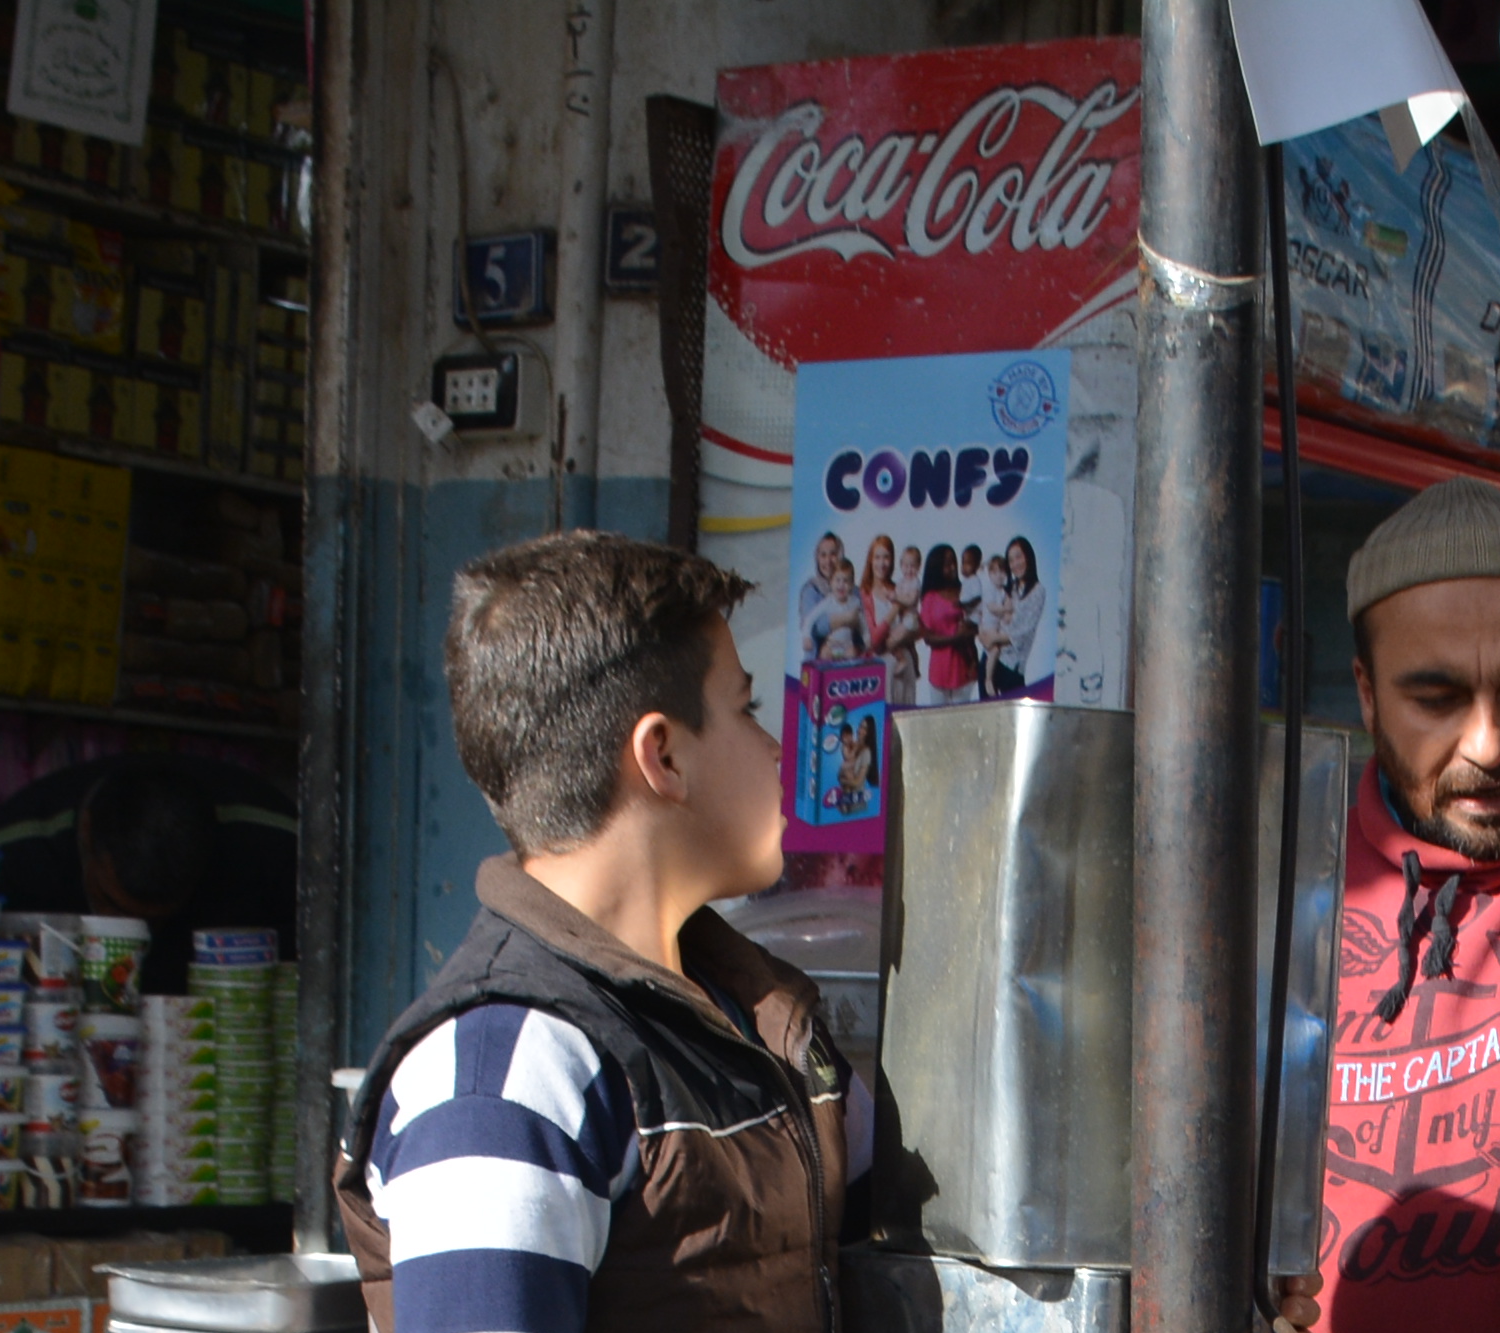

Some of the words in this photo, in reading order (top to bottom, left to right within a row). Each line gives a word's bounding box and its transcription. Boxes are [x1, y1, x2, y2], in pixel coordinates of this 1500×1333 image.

[722, 80, 1141, 269] Coca-Cola
[484, 245, 507, 308] 5
[620, 222, 659, 269] 2
[824, 445, 1030, 511] CONFY
[826, 676, 881, 698] CONFY
[1336, 1061, 1397, 1103] THE
[1355, 1104, 1396, 1155] of
[1427, 1088, 1498, 1149] my
